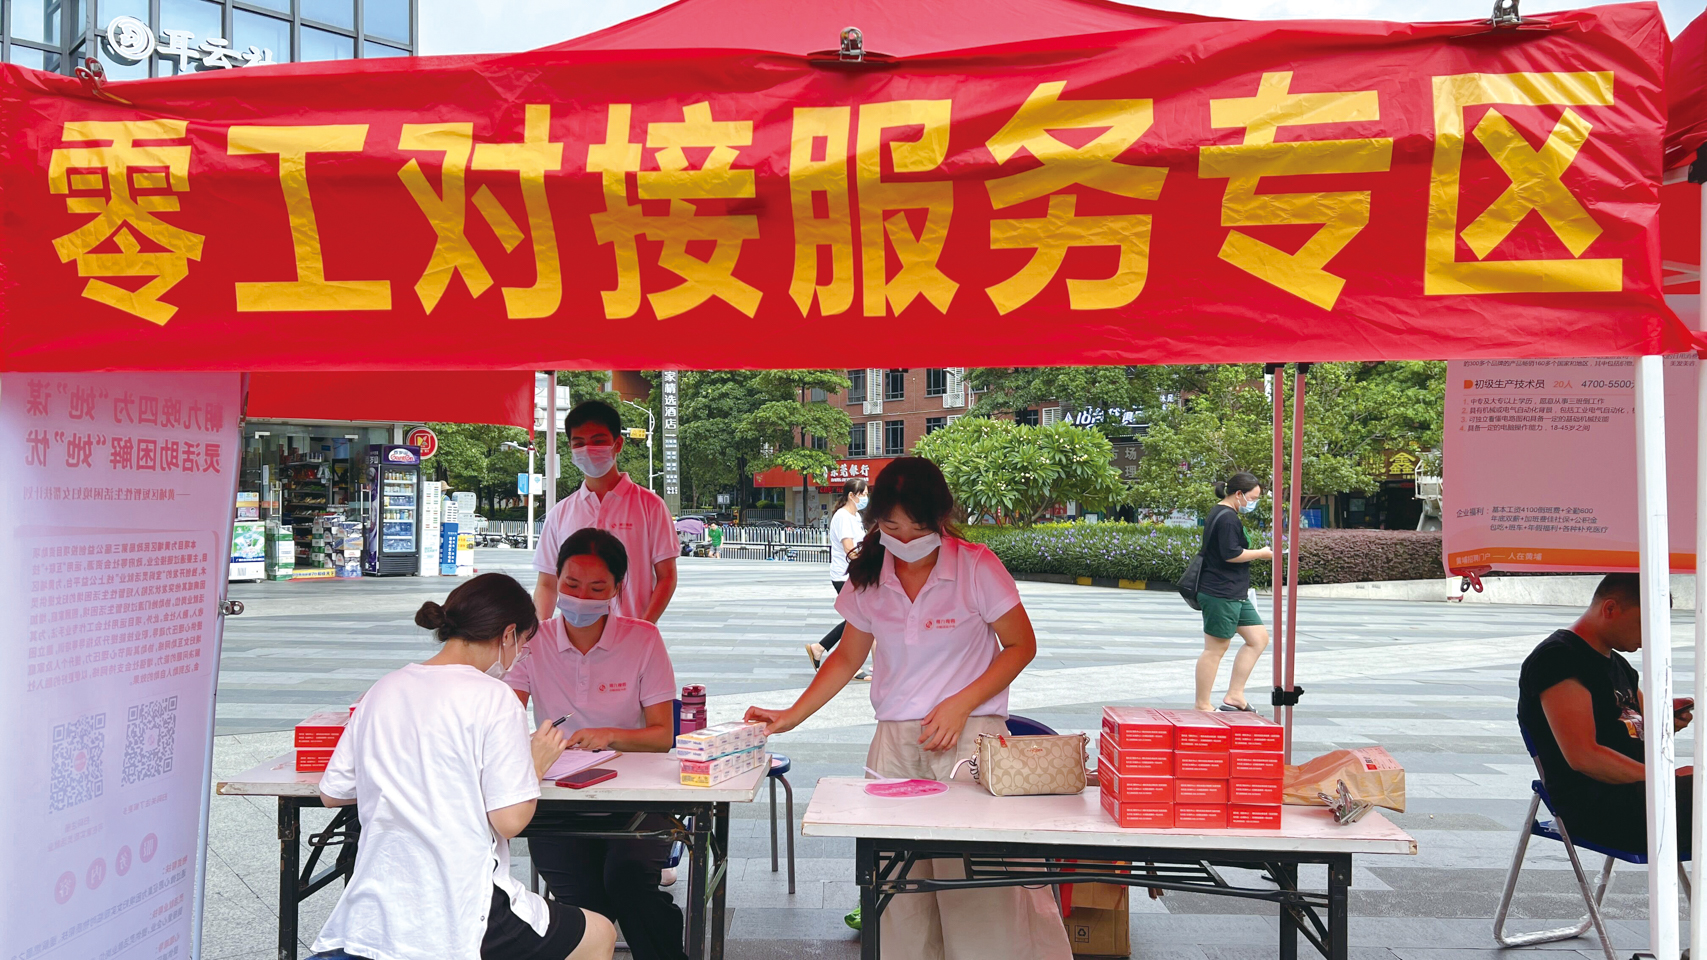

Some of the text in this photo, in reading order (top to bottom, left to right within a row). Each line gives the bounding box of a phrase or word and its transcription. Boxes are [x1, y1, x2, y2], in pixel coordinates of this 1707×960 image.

[48, 71, 1624, 326] 零工对接服务专区
[1474, 379, 1545, 390] 初级生产技术员
[1553, 380, 1573, 389] 20人
[1507, 552, 1542, 561] 人在黄埔
